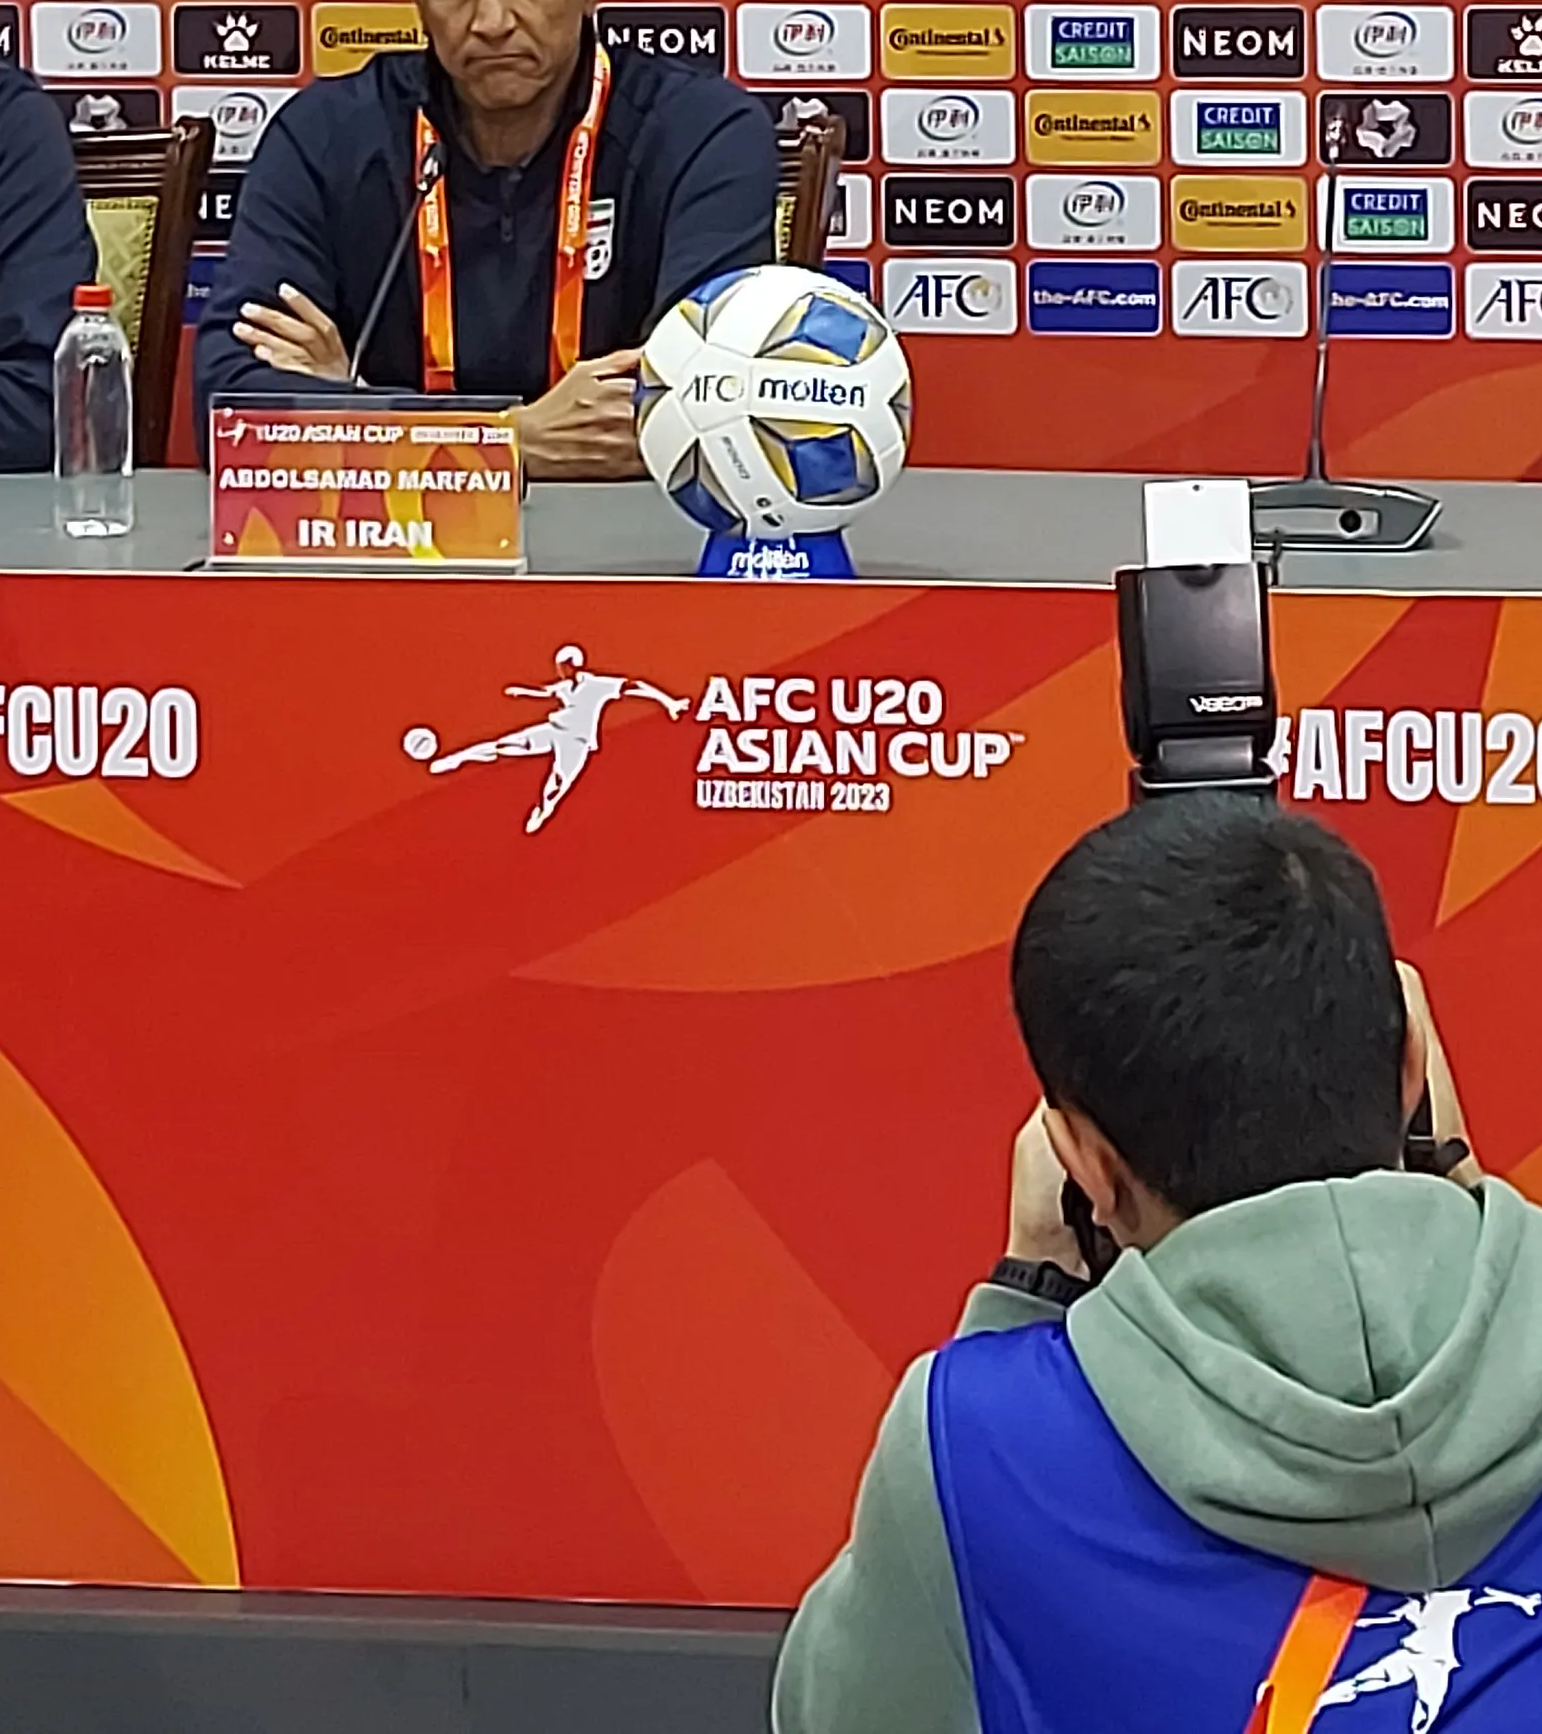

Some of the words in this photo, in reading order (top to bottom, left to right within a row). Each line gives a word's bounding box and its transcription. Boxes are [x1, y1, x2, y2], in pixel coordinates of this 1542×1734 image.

[1057, 22, 1128, 40] CREDIT
[1184, 27, 1293, 56] NEOM
[1203, 107, 1275, 126] CREDIT
[896, 199, 1003, 224] NEOM
[1350, 193, 1422, 212] CREDIT
[893, 275, 988, 317] AFC
[1183, 276, 1279, 322] AFC
[759, 378, 867, 407] molten
[219, 468, 391, 489] ABDOLSAMAD
[397, 470, 510, 490] MARFAVI
[298, 520, 336, 547] IR
[346, 520, 432, 547] IRAN
[696, 677, 816, 724] AFC
[831, 678, 943, 726] U20
[697, 728, 876, 776] ASIAN
[888, 731, 1011, 778] CUP
[831, 782, 890, 812] 2023
